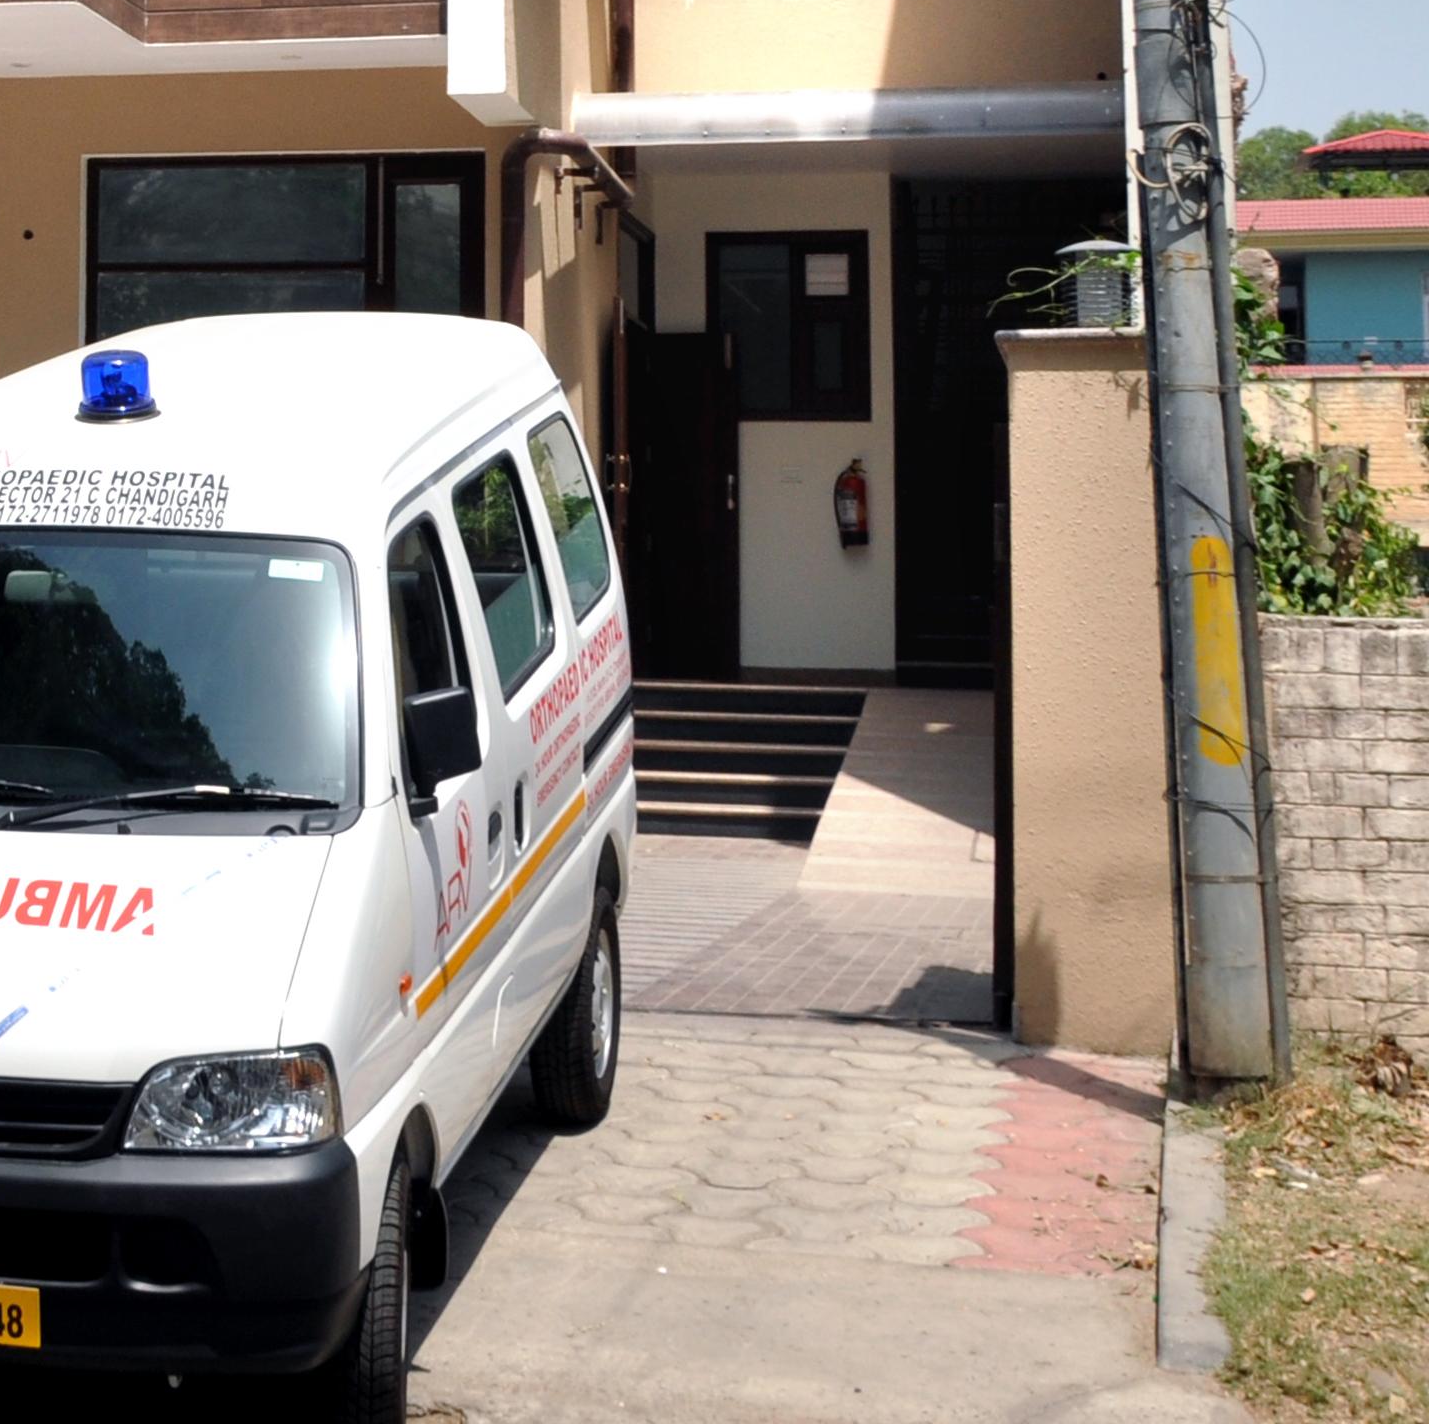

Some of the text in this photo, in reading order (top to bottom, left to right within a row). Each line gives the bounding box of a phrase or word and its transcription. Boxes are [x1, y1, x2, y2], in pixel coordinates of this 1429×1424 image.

[111, 470, 230, 491] HOSPITAL
[60, 486, 81, 504] 21
[87, 486, 100, 504] C
[105, 487, 230, 509] CHANDIGARH
